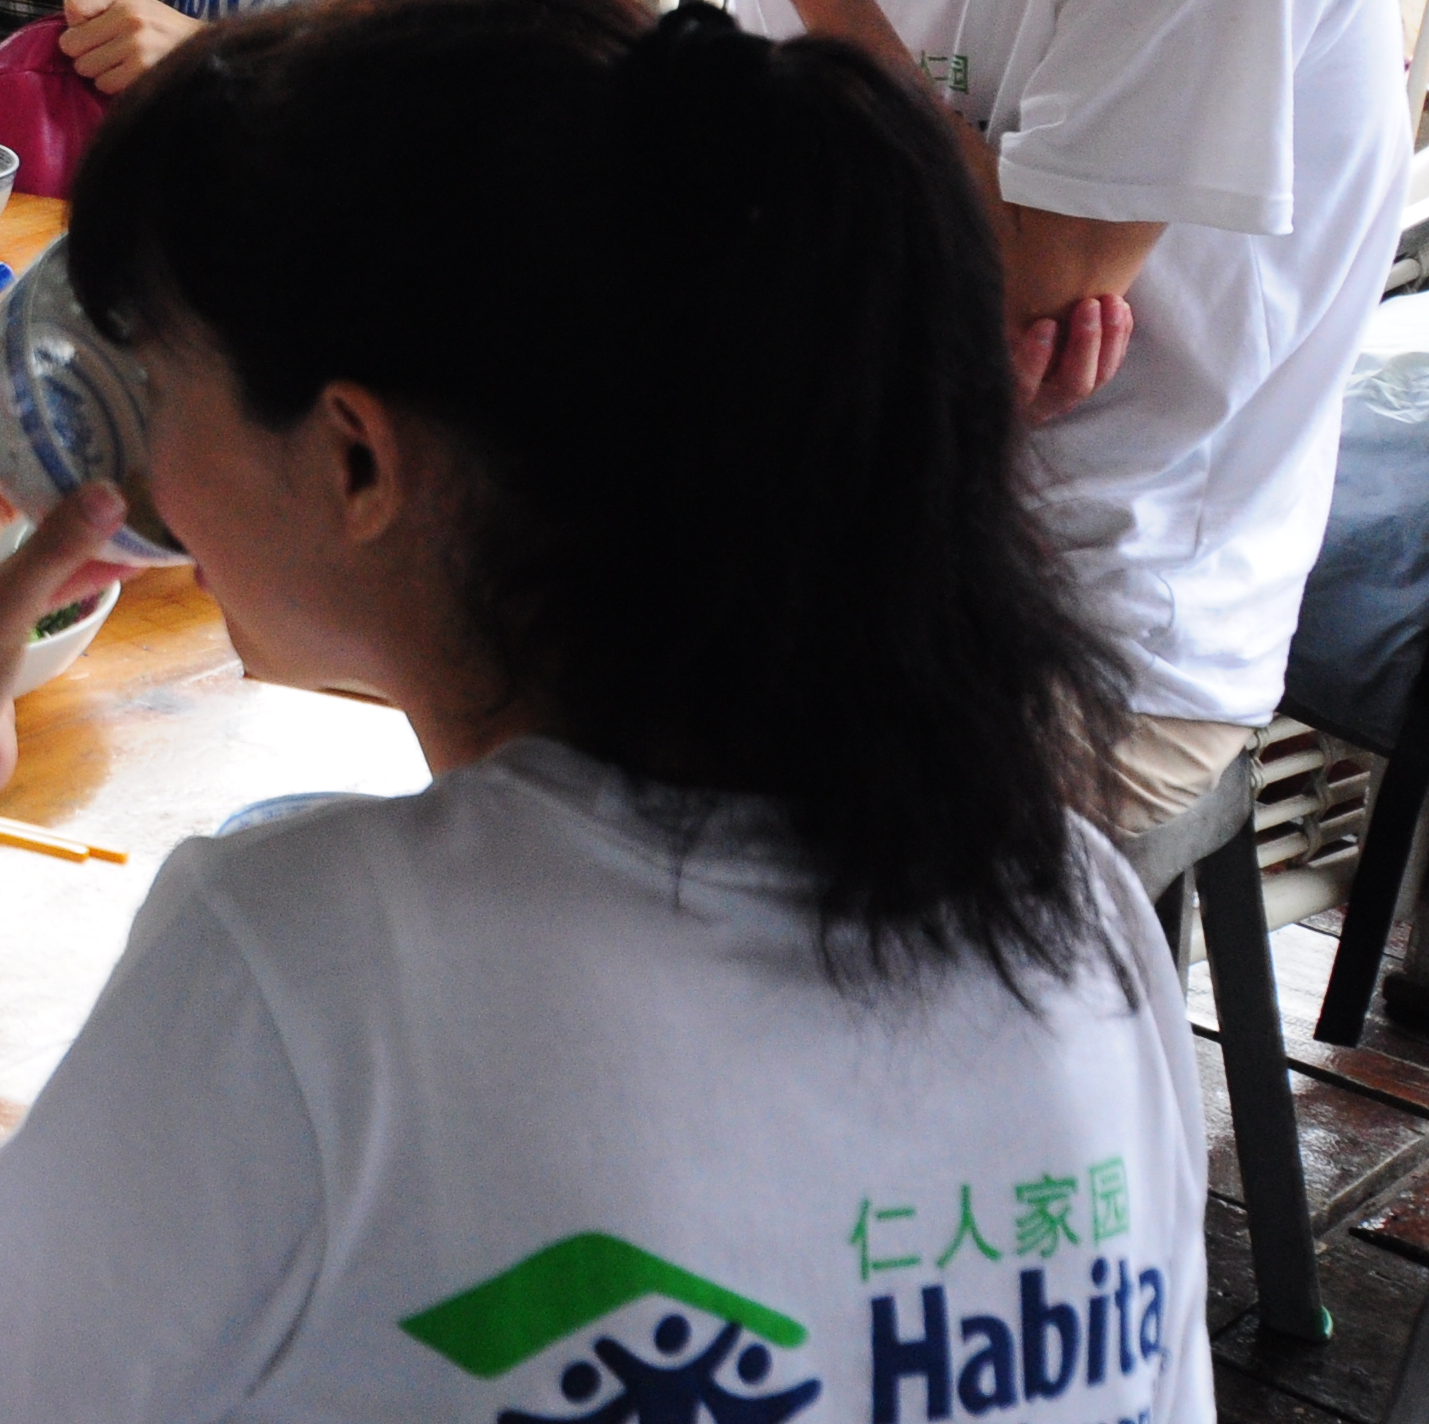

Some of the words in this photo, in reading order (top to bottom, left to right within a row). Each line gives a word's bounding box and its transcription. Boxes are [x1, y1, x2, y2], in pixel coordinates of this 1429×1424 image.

[849, 1155, 1131, 1282] 仁人家园
[870, 1255, 1169, 1424] Habita
